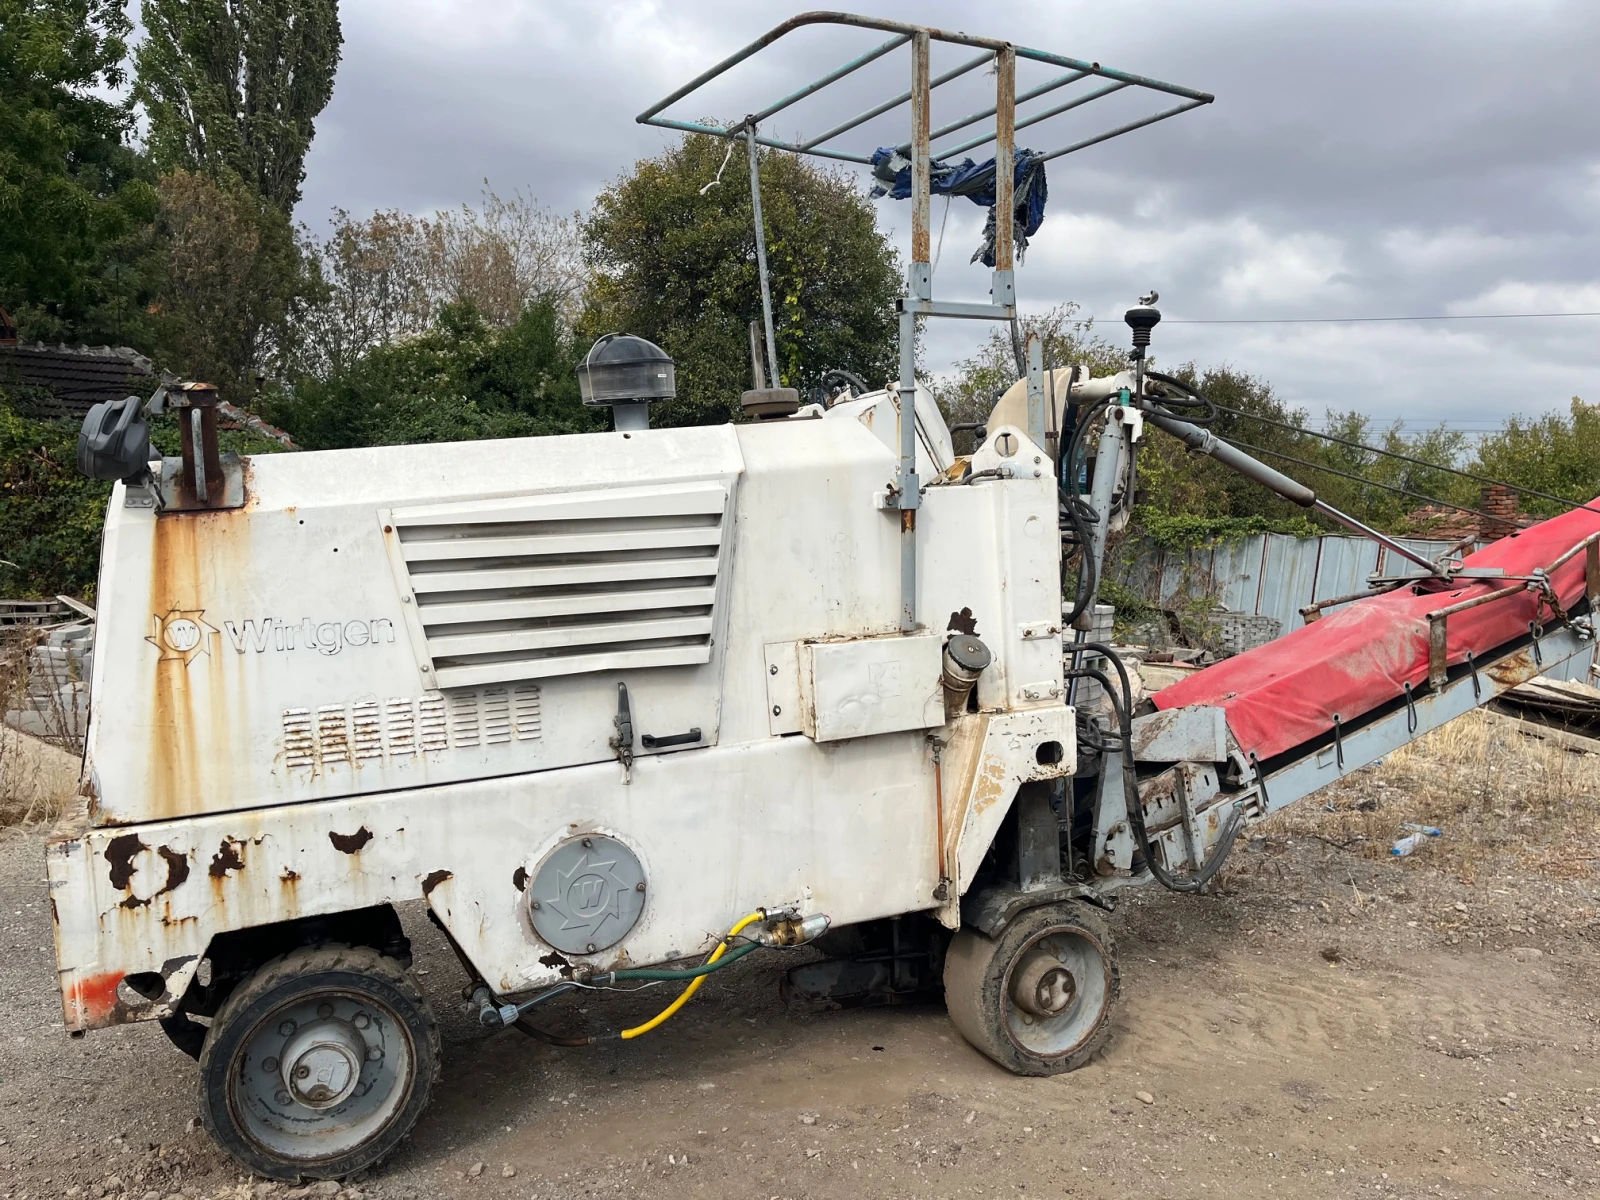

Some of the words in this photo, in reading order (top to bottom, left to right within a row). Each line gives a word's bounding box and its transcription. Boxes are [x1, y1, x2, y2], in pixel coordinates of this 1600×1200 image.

[168, 625, 197, 647] W
[224, 617, 395, 656] Wirtgen
[572, 880, 604, 909] W
